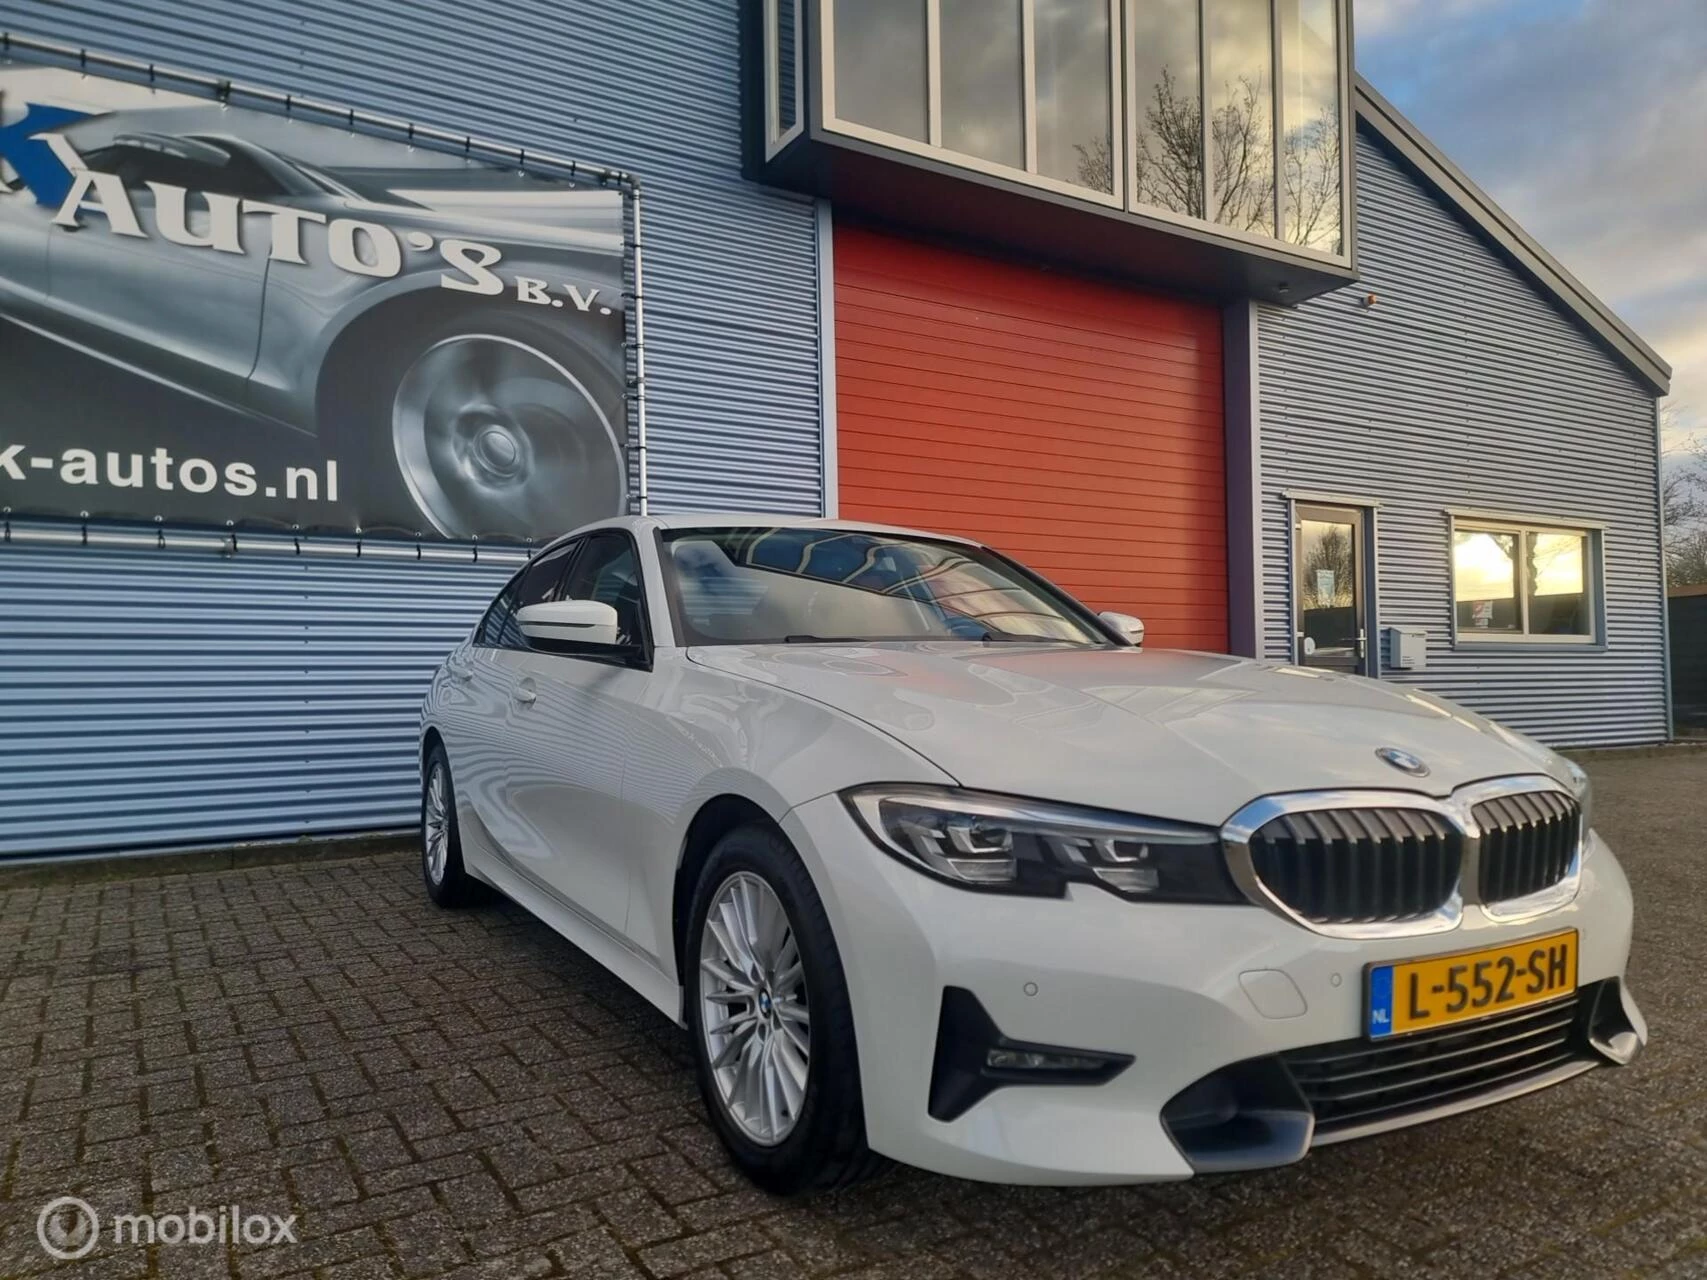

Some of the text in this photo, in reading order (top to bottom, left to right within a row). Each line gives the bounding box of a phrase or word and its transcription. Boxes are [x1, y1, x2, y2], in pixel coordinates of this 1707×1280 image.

[514, 275, 612, 315] B.V.
[1409, 943, 1568, 1020] L-552-SH
[1372, 1008, 1390, 1024] NL
